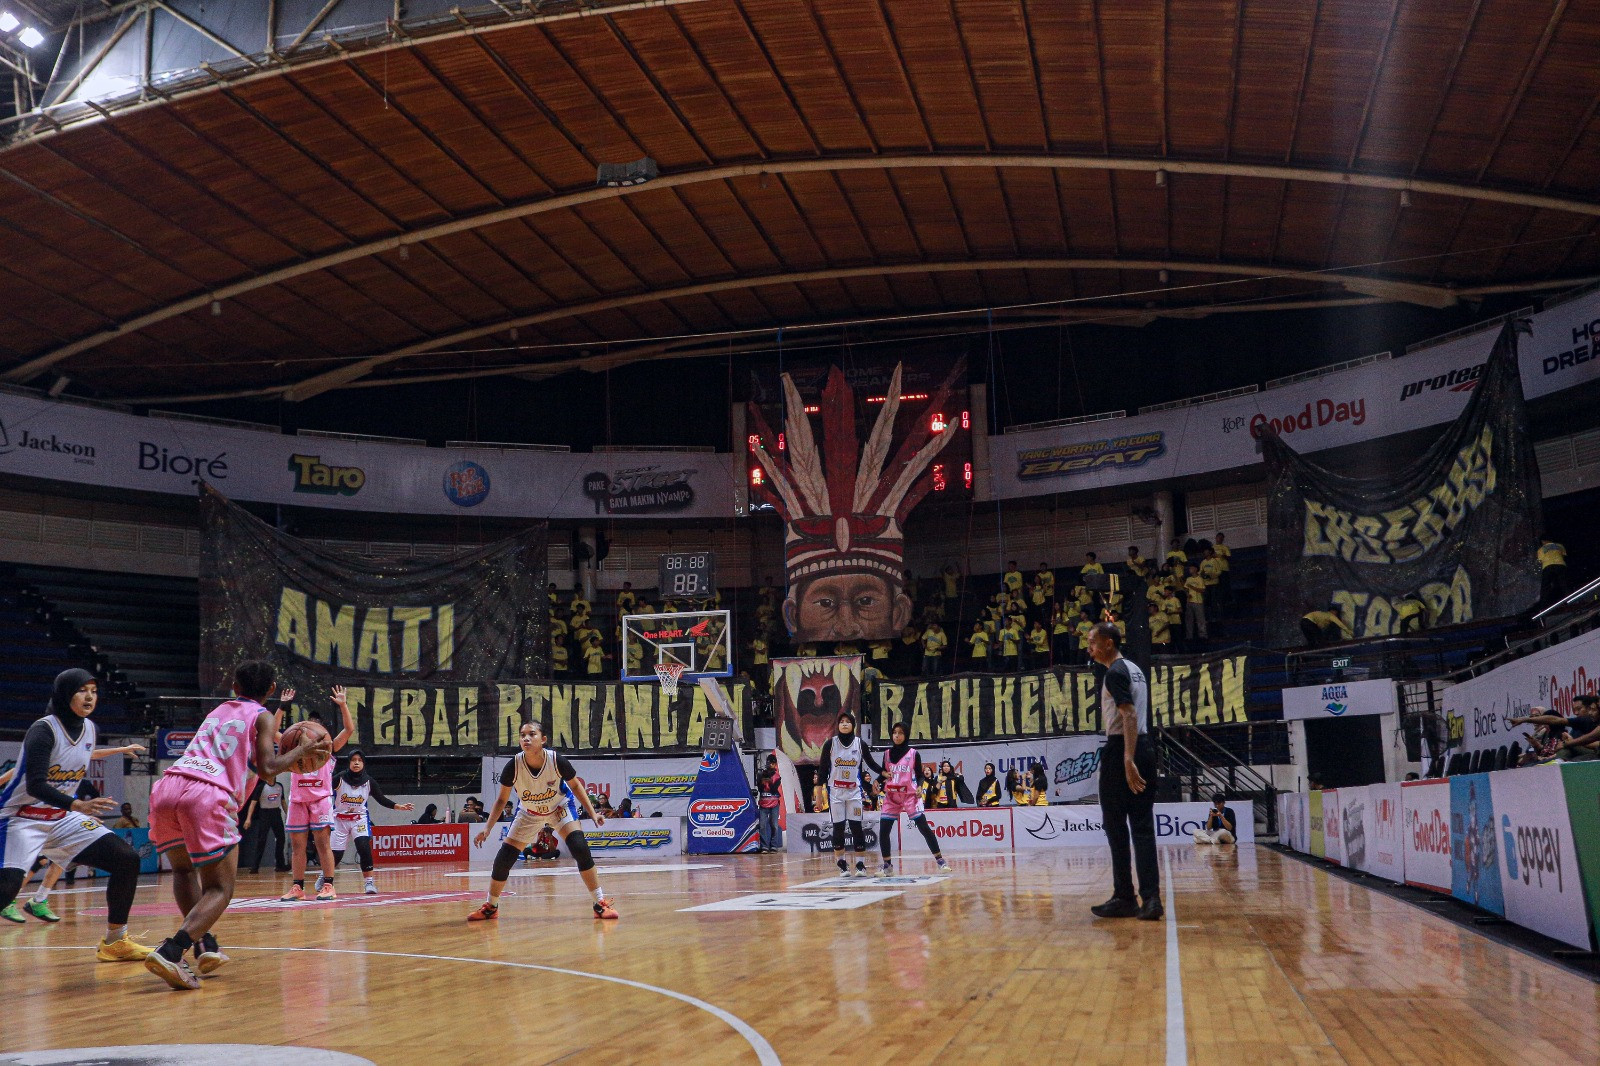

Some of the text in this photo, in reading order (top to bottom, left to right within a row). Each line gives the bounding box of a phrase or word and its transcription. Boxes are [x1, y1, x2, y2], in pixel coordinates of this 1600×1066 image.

[1400, 363, 1487, 401] protea
[1250, 403, 1312, 439] Good
[1317, 399, 1366, 427] Day
[18, 430, 96, 458] Jackson
[1051, 446, 1094, 457] WORTH
[138, 441, 228, 479] Bioré
[293, 453, 366, 490] Taro
[610, 497, 628, 509] GAYA
[630, 494, 655, 507] MAKIN
[275, 586, 455, 673] AMATI
[643, 631, 658, 639] One
[1332, 658, 1349, 668] EXIT
[1321, 685, 1348, 700] AQUA
[346, 687, 479, 747] TEBAS
[879, 679, 981, 740] RAIH
[1474, 702, 1497, 738] Bioré
[191, 717, 246, 760] 26
[1447, 709, 1465, 740] Taro
[521, 788, 558, 802] Smada
[705, 813, 721, 821] DBL
[969, 820, 1005, 841] Day
[1062, 818, 1105, 833] Jacks
[1155, 814, 1213, 837] Bior
[372, 835, 400, 850] HOT
[415, 833, 462, 848] CREAM
[1413, 809, 1434, 853] Good
[1434, 809, 1450, 855] Da
[424, 848, 455, 856] PEMANASAN
[1517, 825, 1563, 893] gopay
